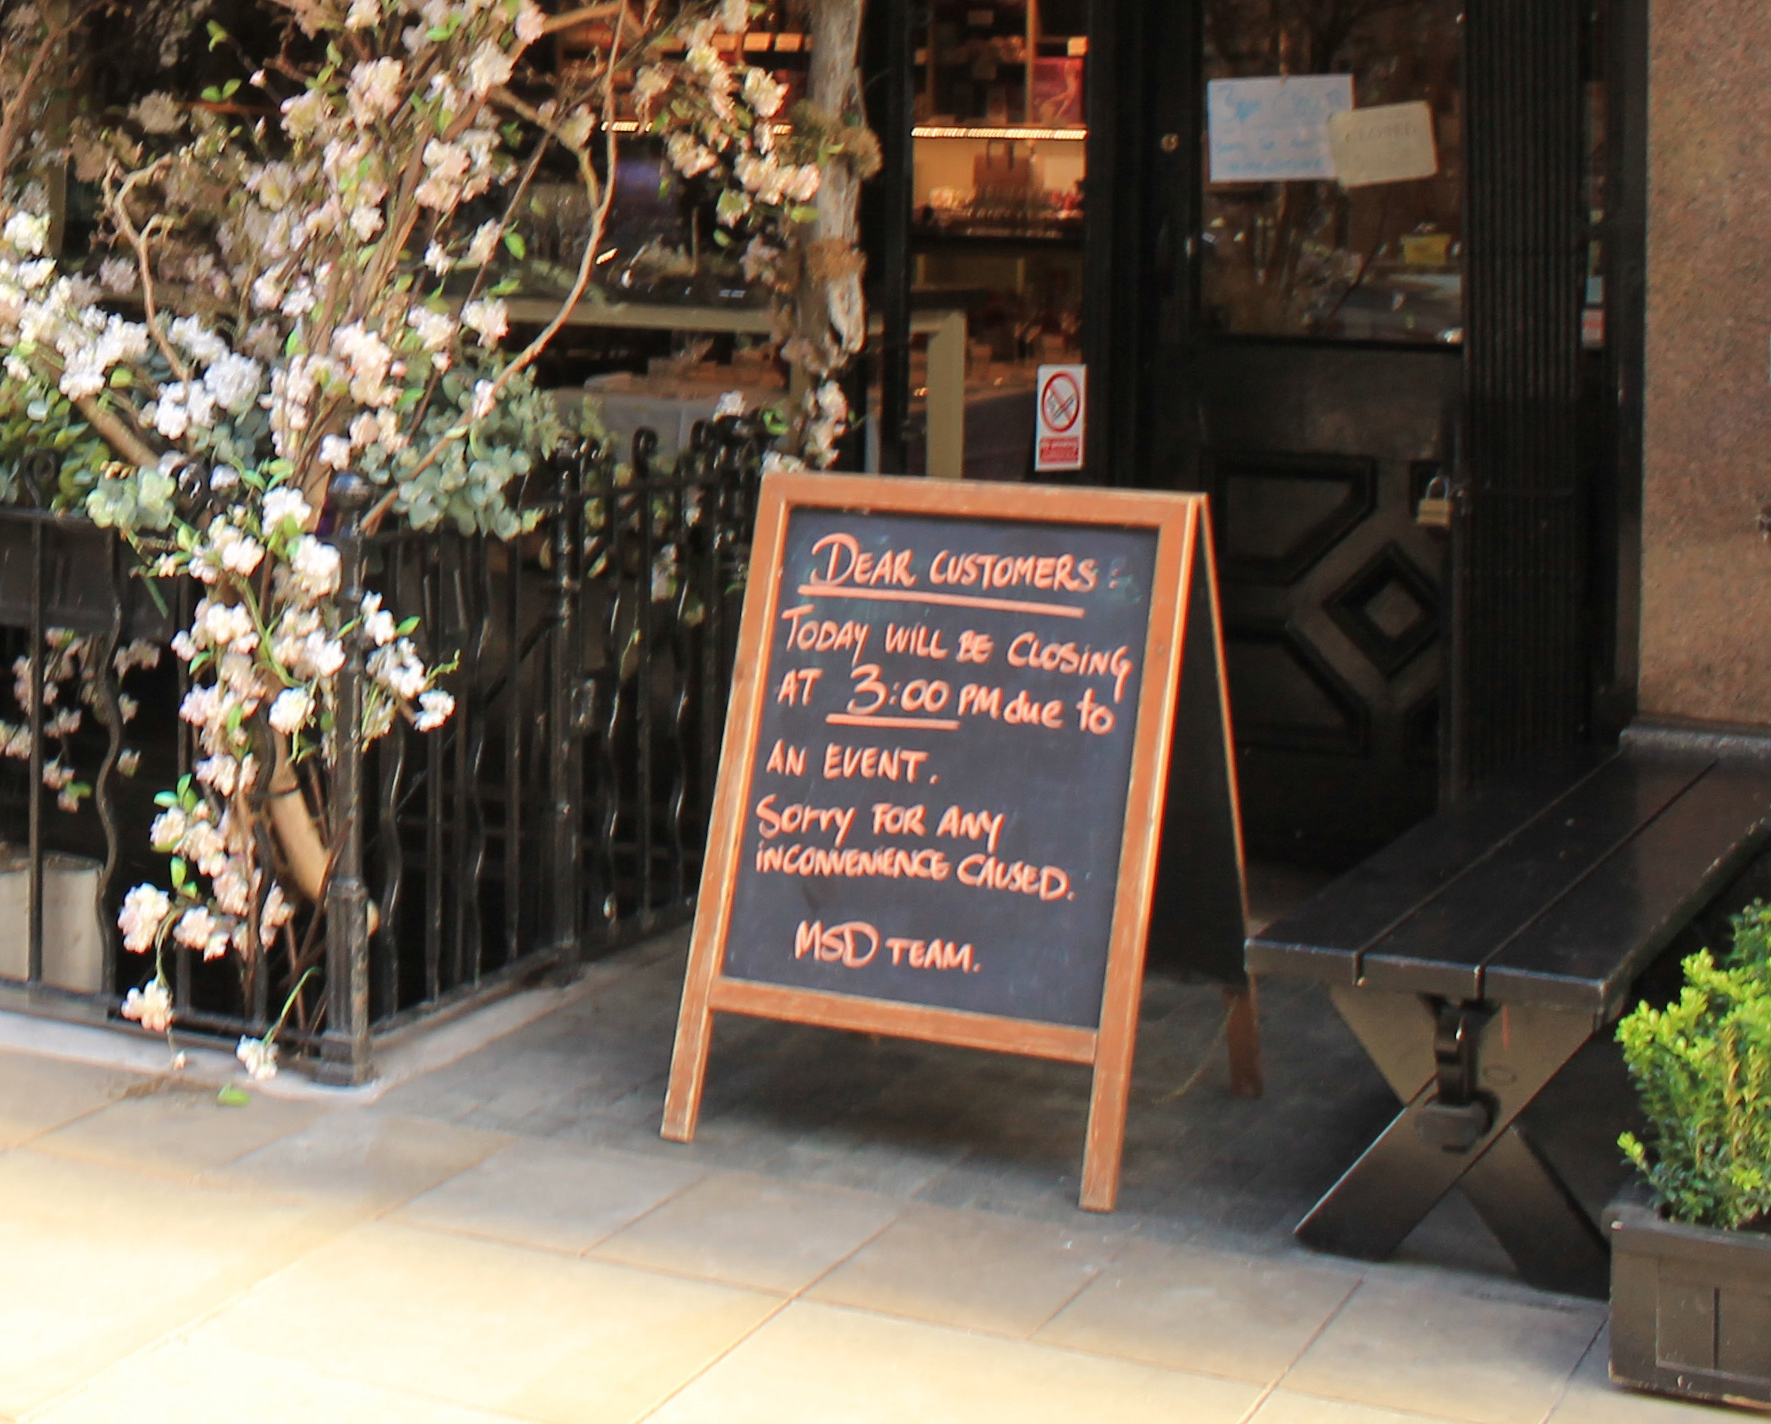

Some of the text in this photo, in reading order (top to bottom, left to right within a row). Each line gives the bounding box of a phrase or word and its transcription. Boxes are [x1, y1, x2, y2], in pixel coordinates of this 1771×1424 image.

[810, 533, 918, 588] DEAR
[781, 604, 870, 666] TODAY
[956, 629, 994, 664] BE
[776, 663, 1116, 735] AT 3:00 PM due to
[766, 739, 807, 777] AN
[872, 803, 927, 836] FOR
[936, 805, 1005, 854] ANY
[794, 920, 881, 969] MSD
